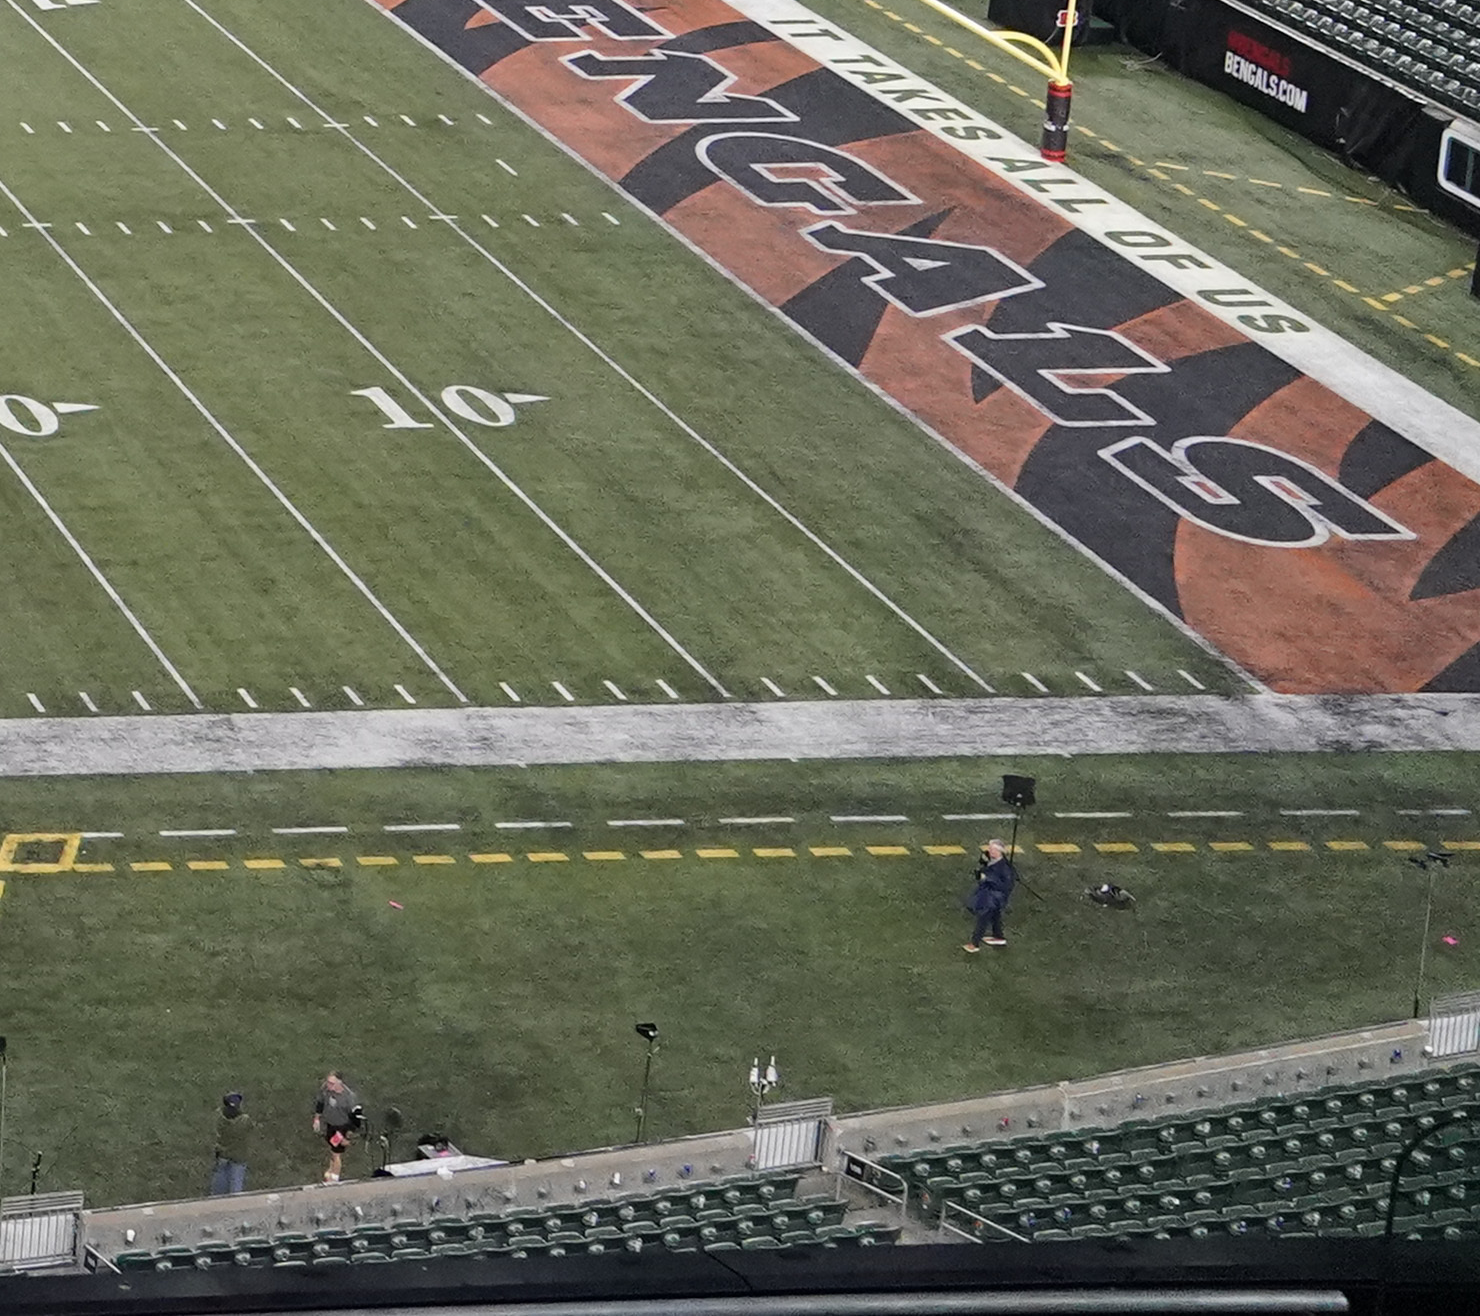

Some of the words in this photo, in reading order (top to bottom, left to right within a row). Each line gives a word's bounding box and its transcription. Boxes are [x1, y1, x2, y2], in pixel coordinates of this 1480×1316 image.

[768, 18, 843, 42] IT
[830, 54, 1004, 143] TAKES
[989, 156, 1109, 214] ALL
[1104, 230, 1213, 270] OF
[1197, 288, 1311, 335] US
[1224, 50, 1308, 113] BENGALS.COM
